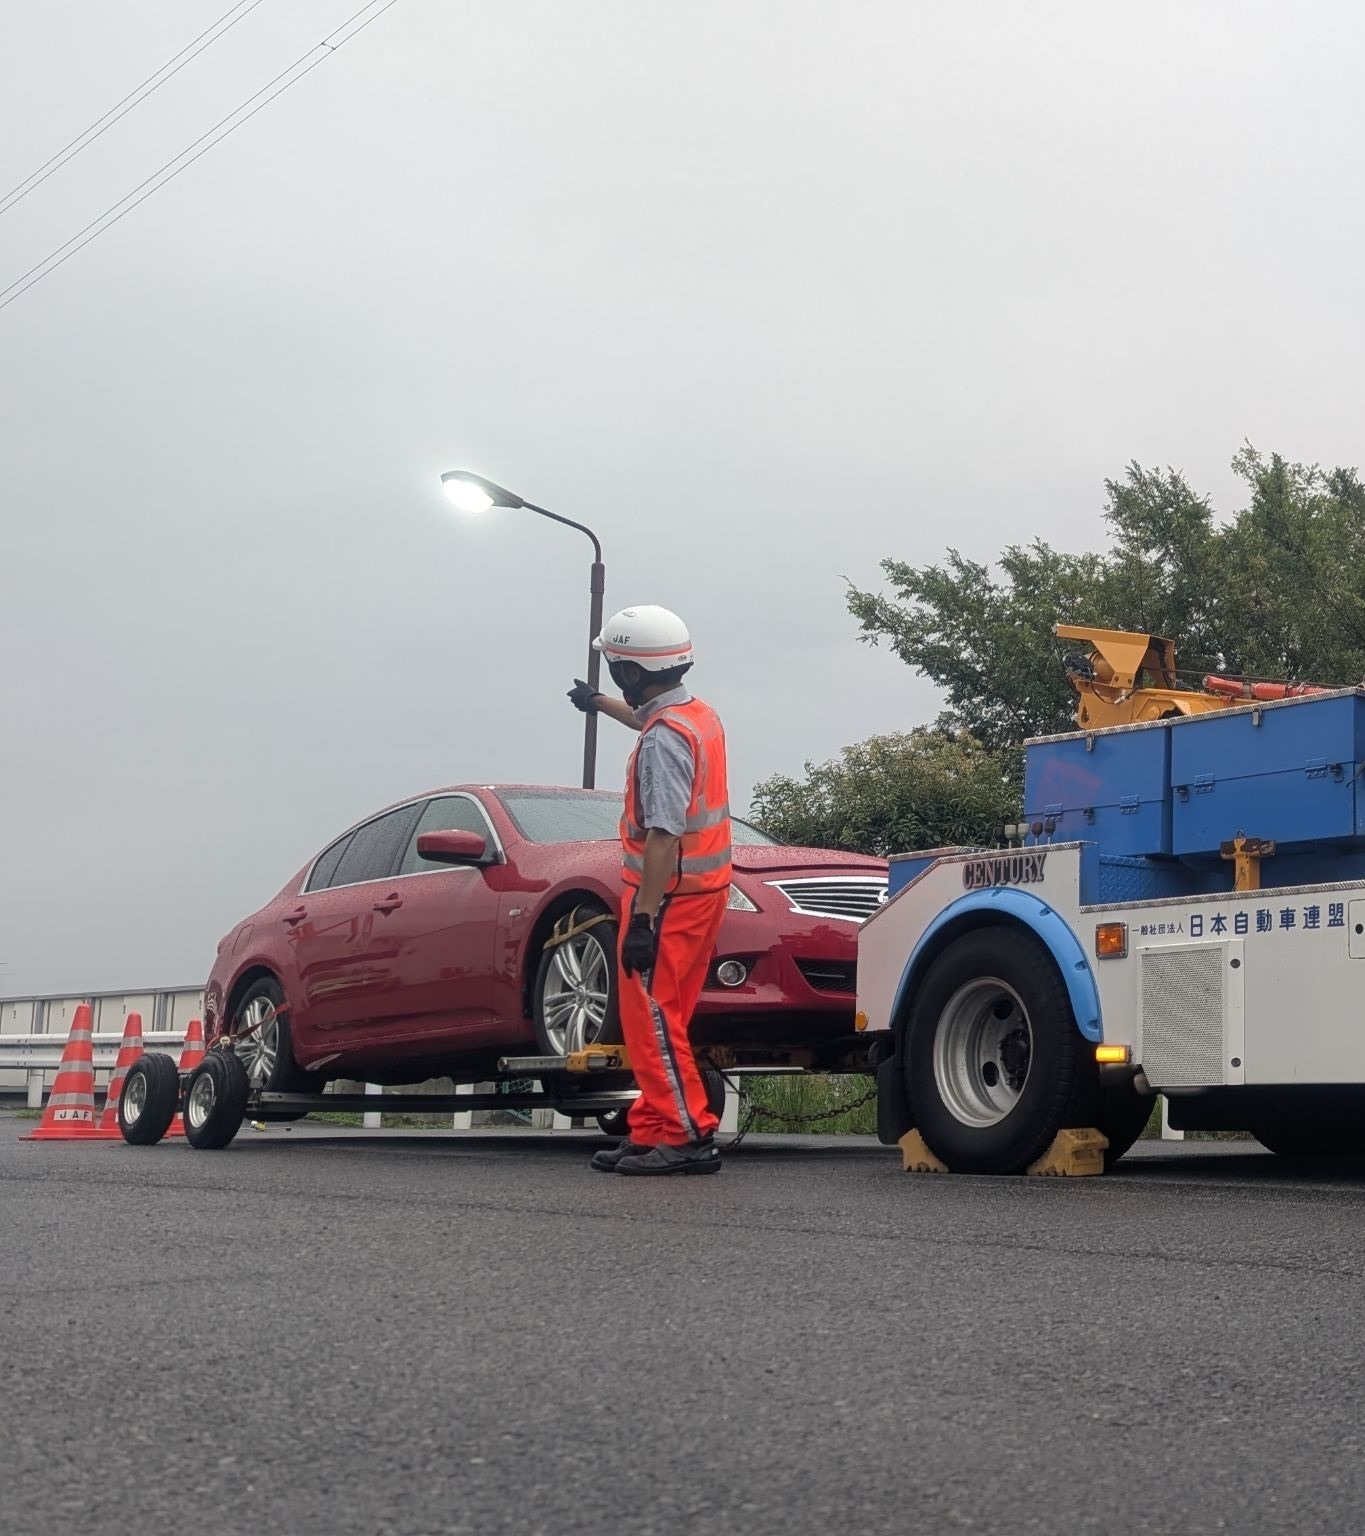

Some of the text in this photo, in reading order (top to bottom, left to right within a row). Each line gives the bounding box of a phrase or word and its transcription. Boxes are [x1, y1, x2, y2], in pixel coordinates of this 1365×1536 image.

[613, 634, 631, 645] JAF
[962, 853, 1047, 890] CENTURY
[1131, 902, 1345, 938] 一般社団法人 日本自動車連盟
